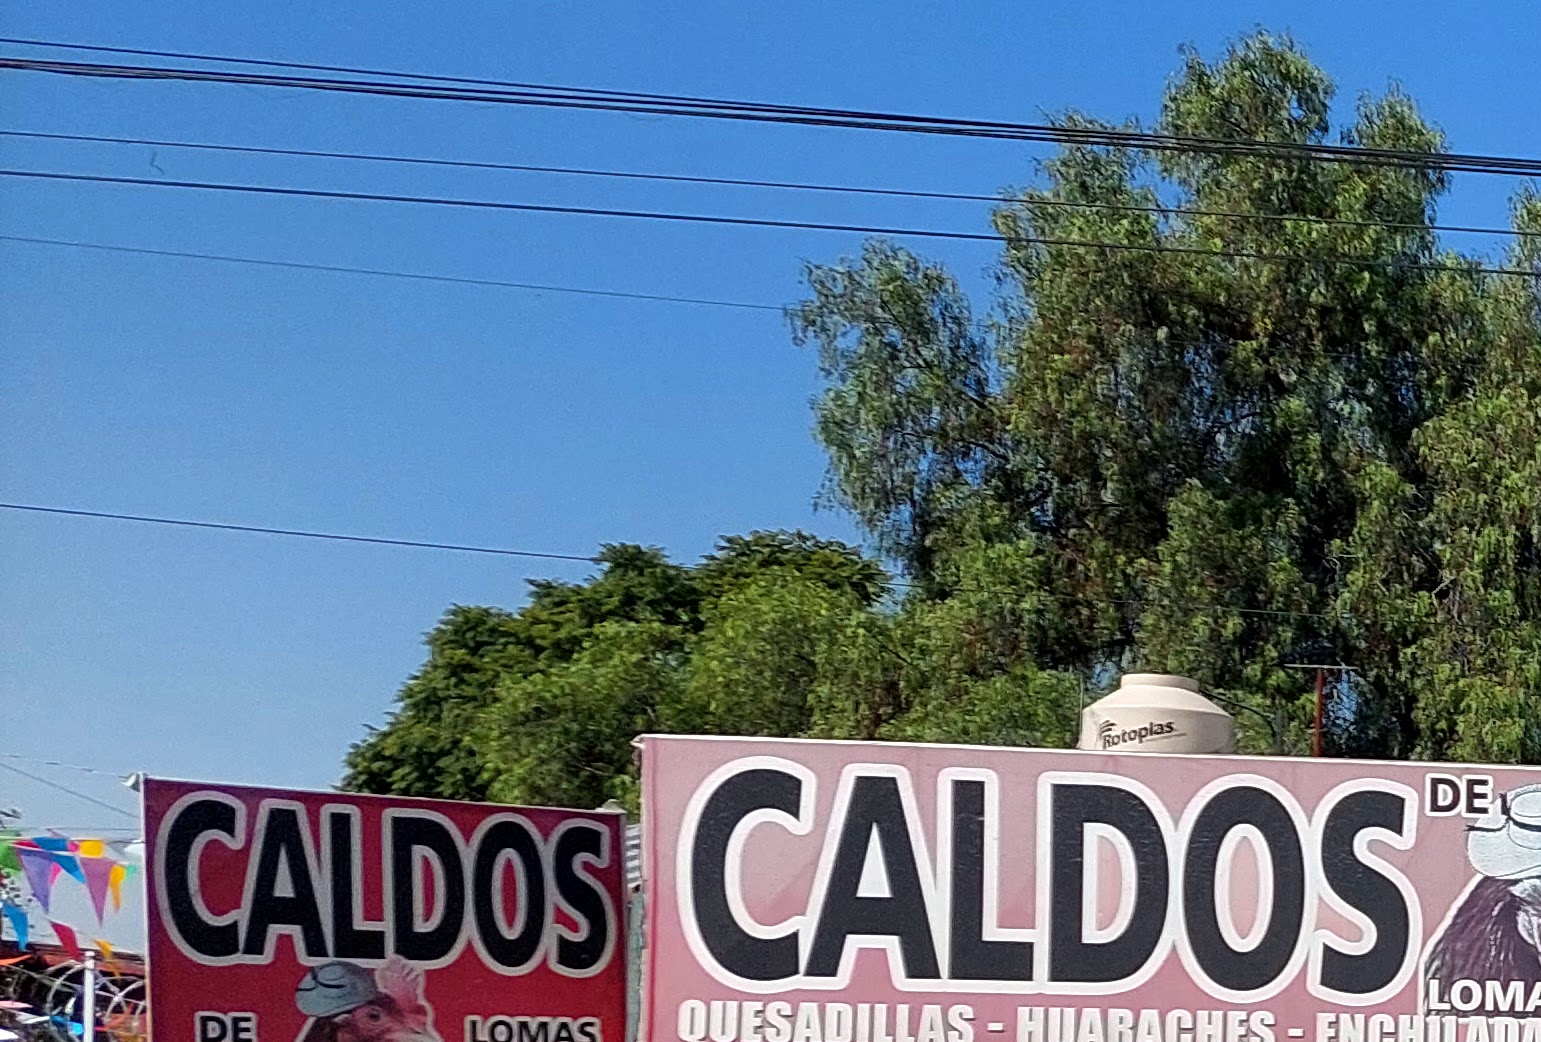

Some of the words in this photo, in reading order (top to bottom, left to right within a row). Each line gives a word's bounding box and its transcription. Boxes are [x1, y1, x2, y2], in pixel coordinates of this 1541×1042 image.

[1102, 720, 1176, 750] Rotoplas
[1429, 777, 1490, 815] DE
[162, 796, 614, 973] CALDOS
[690, 767, 1410, 995] CALDOS
